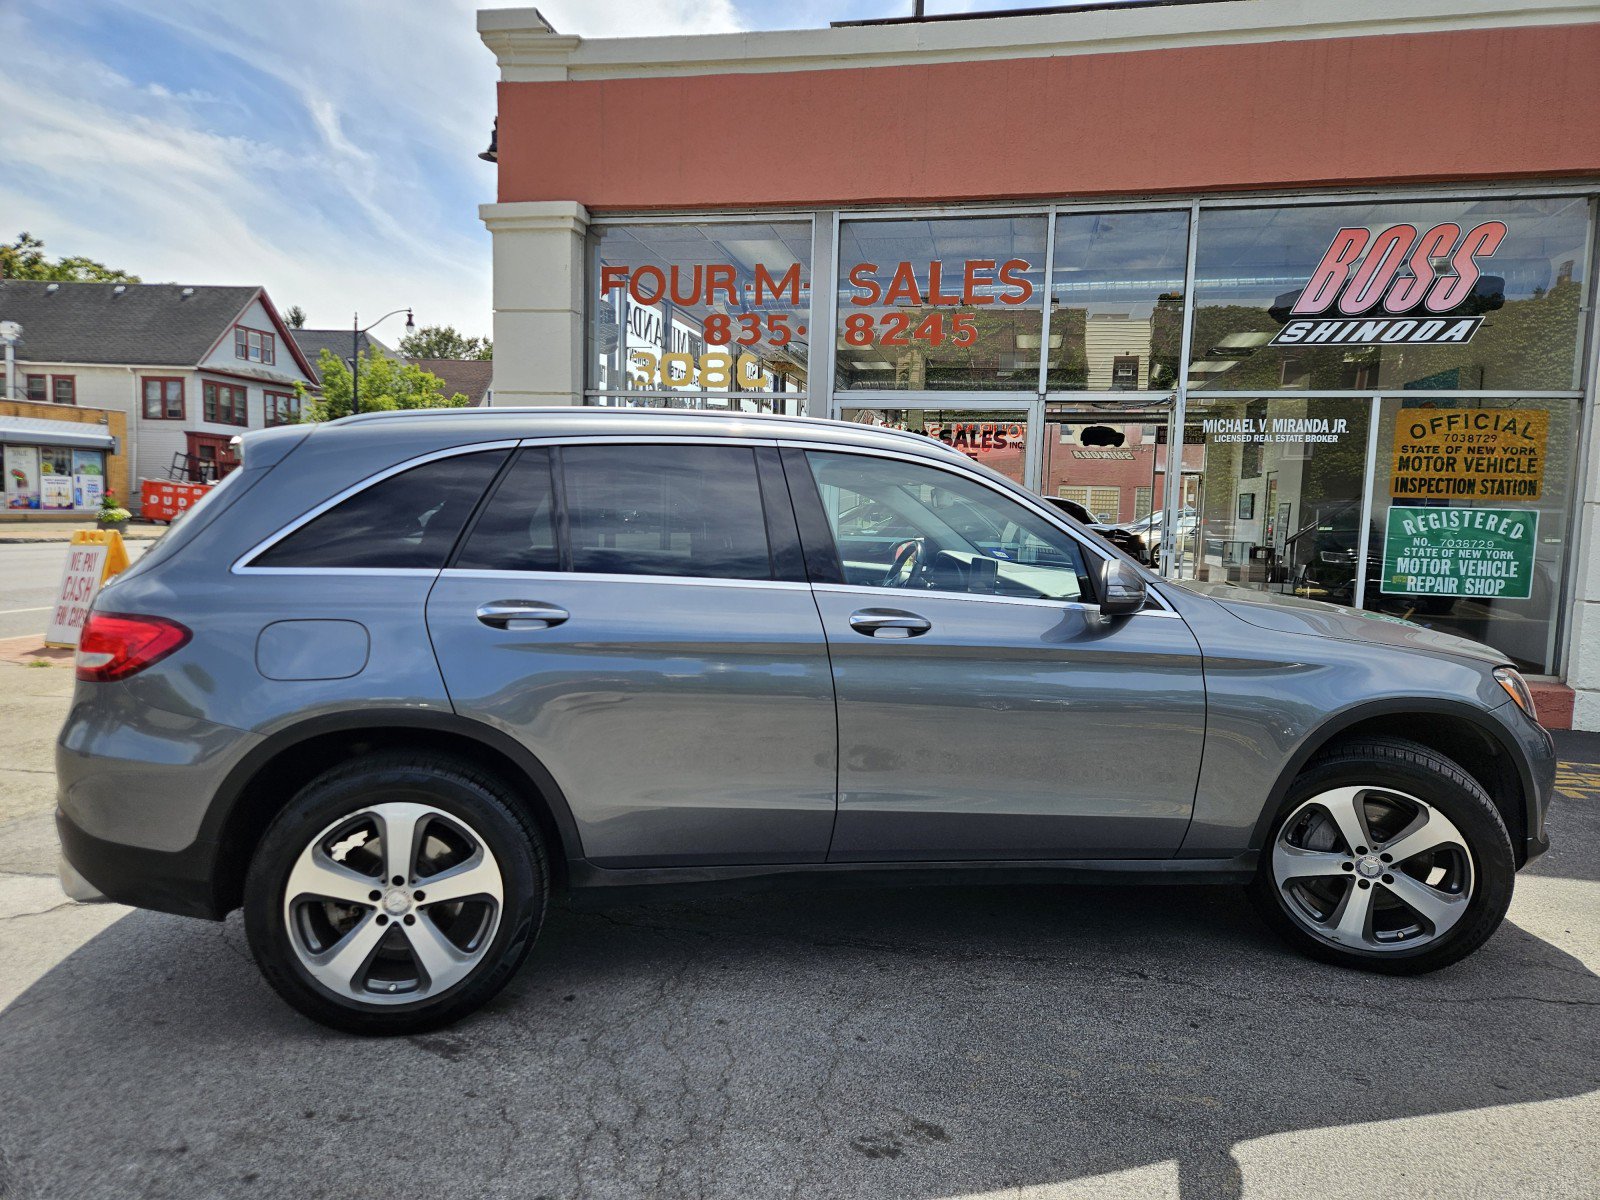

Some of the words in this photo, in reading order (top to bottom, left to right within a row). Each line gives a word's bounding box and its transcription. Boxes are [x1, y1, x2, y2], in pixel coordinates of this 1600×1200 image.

[1290, 220, 1508, 315] BOSS
[849, 258, 1034, 307] SALES
[844, 312, 979, 347] 8245
[1278, 320, 1476, 343] SHINODA
[1202, 418, 1256, 434] MICHAEL
[1259, 418, 1269, 434] V.
[1272, 418, 1329, 434] MIRANDA
[1331, 418, 1350, 434] JR.
[1409, 413, 1536, 440] OFFICIAL
[938, 429, 1008, 450] SALES
[1214, 434, 1252, 443] LICENSED
[1254, 434, 1274, 443] REAL
[1276, 435, 1304, 443] ESTATE
[1305, 435, 1339, 443] BROKER
[1444, 433, 1498, 443] 7038729
[1401, 445, 1440, 454] STATE
[1445, 445, 1464, 455] OF
[1467, 446, 1498, 455] NEW
[1501, 446, 1537, 456] YORK
[1397, 455, 1456, 473] MOTOR
[1463, 457, 1538, 474] VEHICLE
[1394, 477, 1476, 494] INSPECTION
[1480, 478, 1538, 496] STATION
[1402, 510, 1525, 540] REGISTERED
[1413, 537, 1432, 547] NO.
[1440, 538, 1495, 549] 7038729
[83, 552, 100, 572] PAY
[1403, 547, 1438, 557] STATE
[1442, 548, 1455, 558] OF
[1458, 549, 1482, 559] NEW
[1486, 550, 1515, 560] YORK
[1396, 557, 1451, 575] MOTOR
[1459, 559, 1520, 578] VEHICLE
[62, 575, 95, 603] CASH
[1406, 576, 1459, 594] REPAIR
[1464, 578, 1506, 596] SHOP
